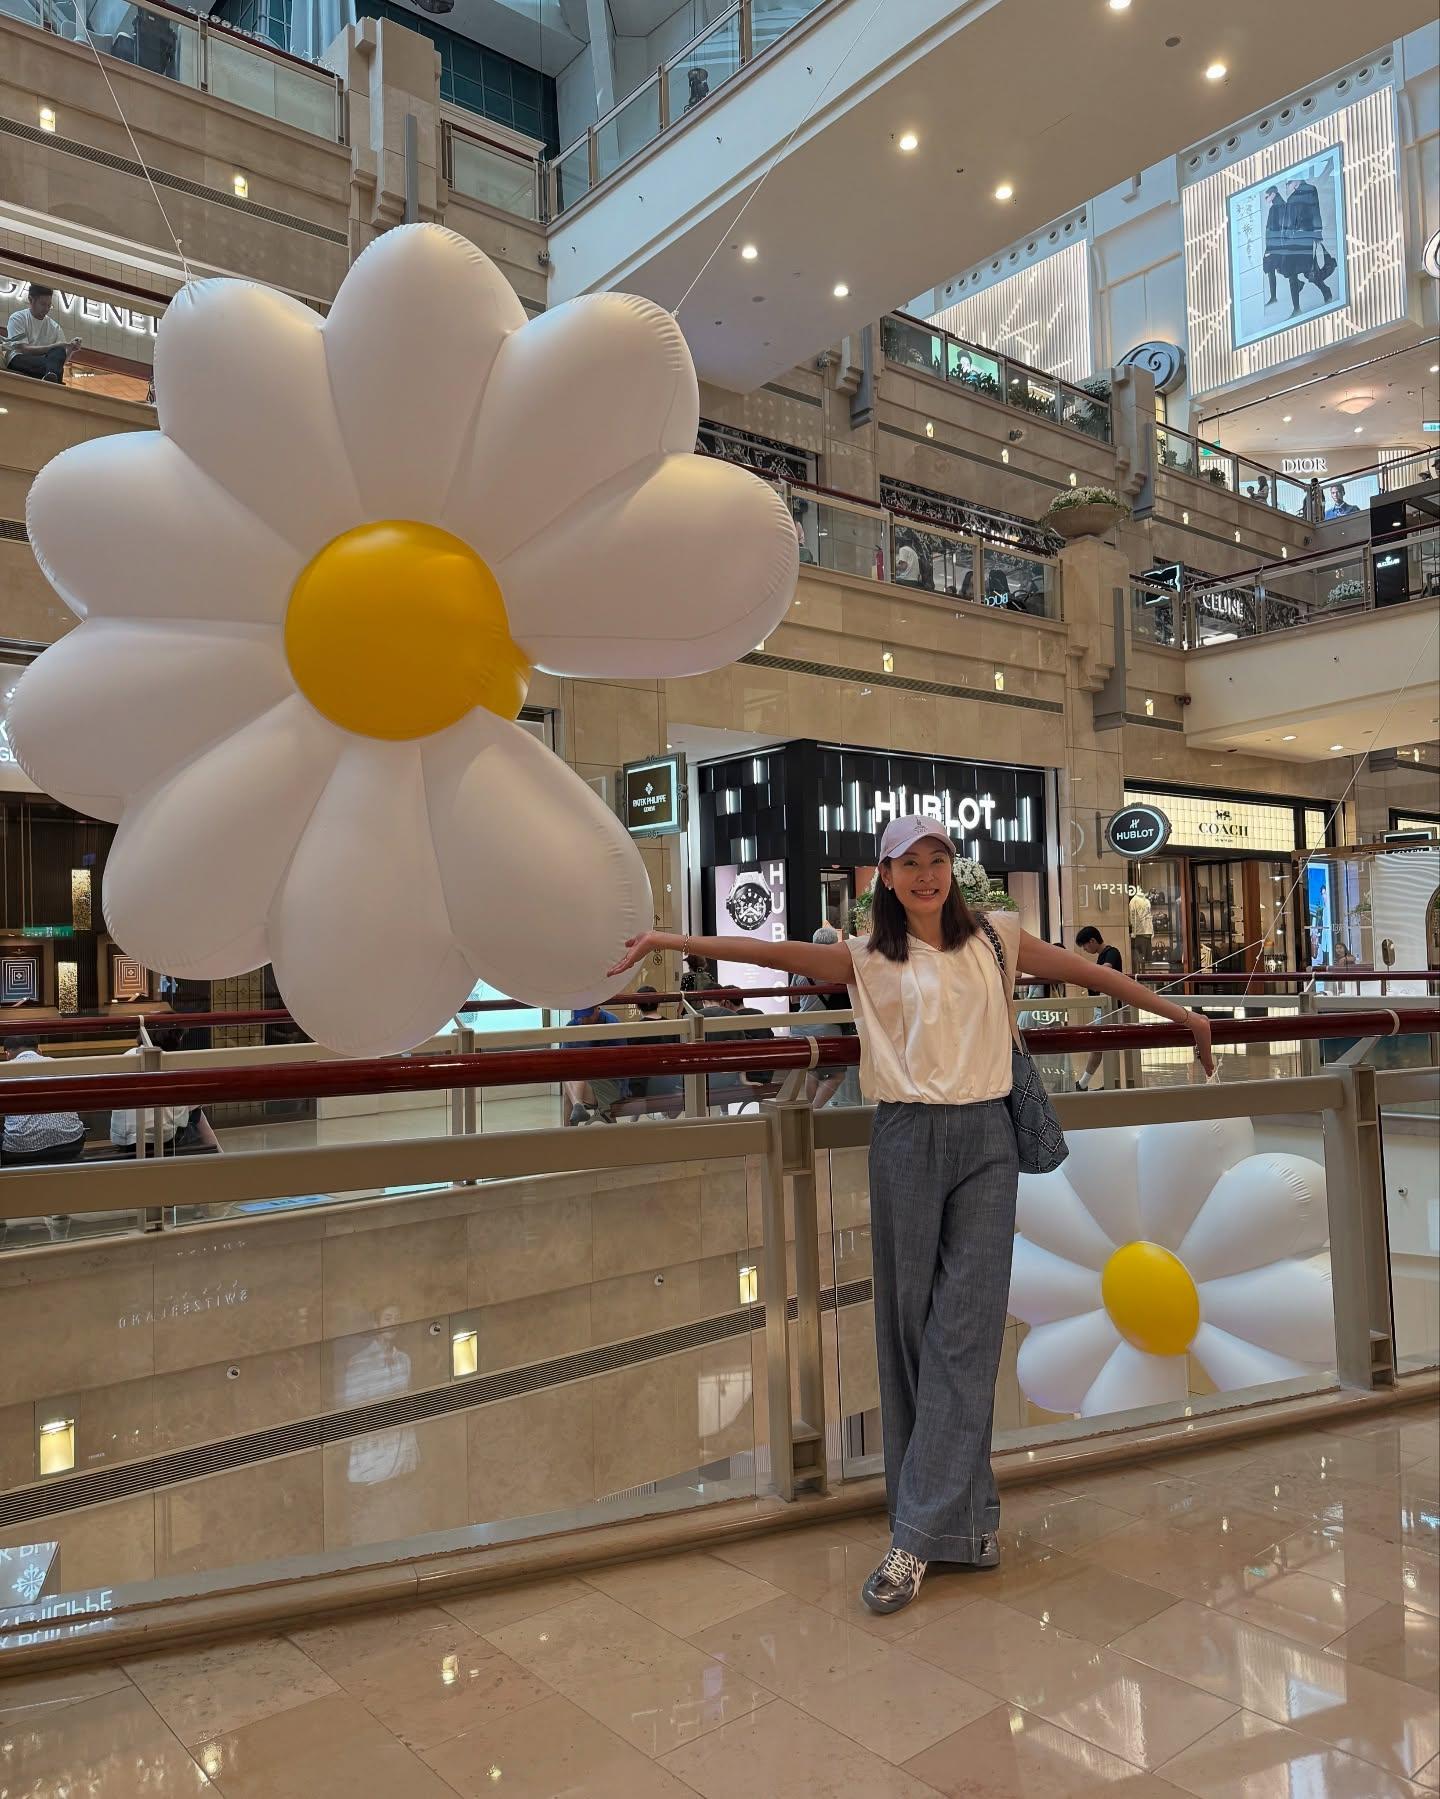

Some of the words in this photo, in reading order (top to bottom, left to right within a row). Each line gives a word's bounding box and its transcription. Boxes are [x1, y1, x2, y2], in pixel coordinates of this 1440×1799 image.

[1282, 458, 1328, 473] DIOR
[1202, 593, 1244, 618] CELINE
[632, 797, 647, 807] PATEK
[647, 794, 667, 805] PHILIPPE
[875, 790, 996, 830] HUBLOT
[1116, 828, 1155, 841] HUBLOT
[1199, 822, 1248, 837] COACH
